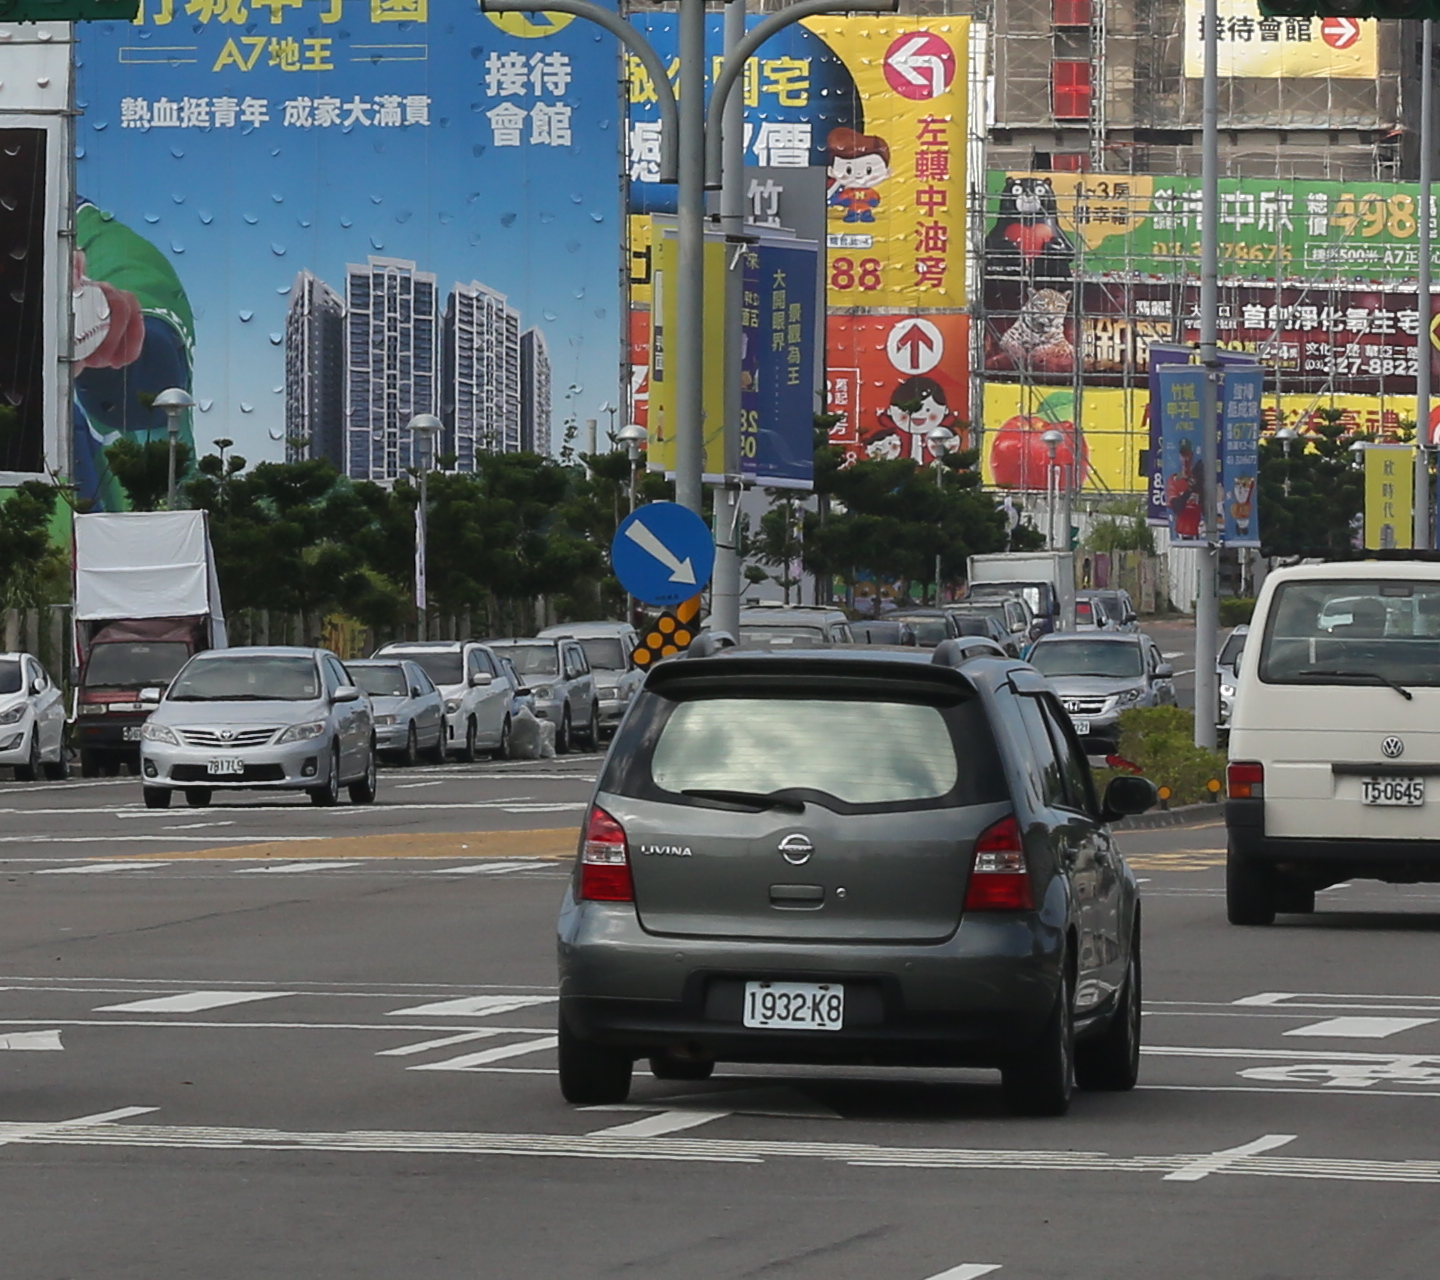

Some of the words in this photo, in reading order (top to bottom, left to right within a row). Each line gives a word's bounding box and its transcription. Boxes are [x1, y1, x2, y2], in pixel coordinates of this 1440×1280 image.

[212, 36, 335, 73] A7地王
[484, 51, 572, 97] 接待
[121, 96, 271, 129] 熱血挺青年
[283, 95, 432, 129] 成家大滿貫
[484, 100, 573, 147] 會館
[914, 113, 950, 289] 左轉中油旁
[1330, 192, 1419, 239] 498
[1190, 304, 1231, 317] 大口
[1362, 781, 1423, 801] T5-0645
[640, 845, 693, 857] LIVINA
[748, 991, 842, 1023] 1932-K8
